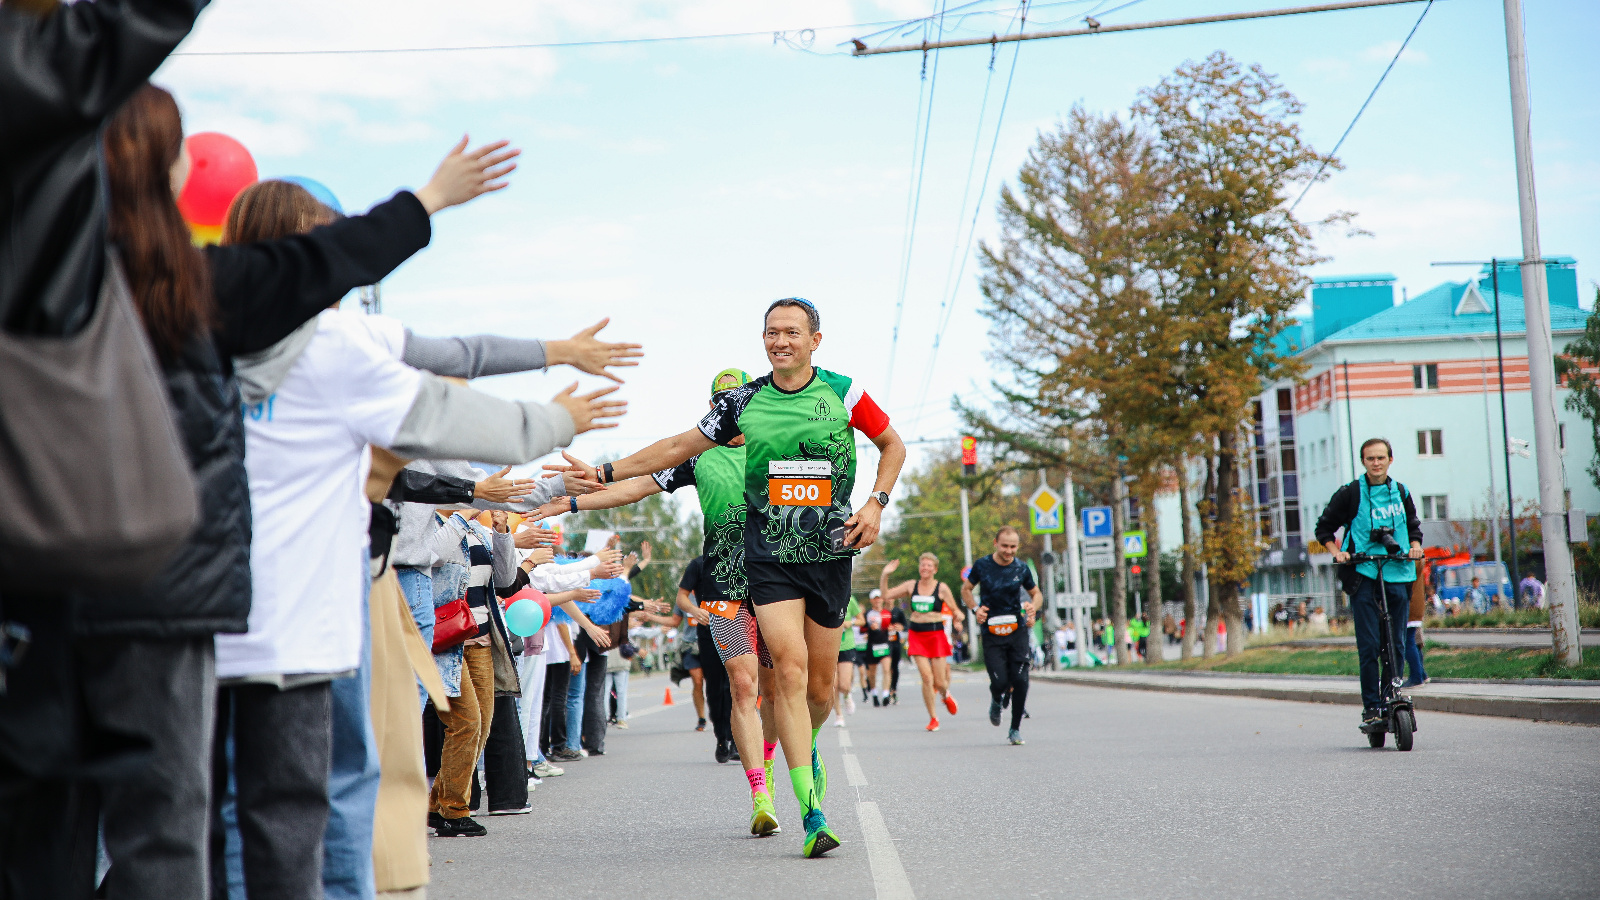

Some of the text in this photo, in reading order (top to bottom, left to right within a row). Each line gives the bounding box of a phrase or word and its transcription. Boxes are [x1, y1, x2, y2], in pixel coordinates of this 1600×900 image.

[781, 484, 819, 501] 500
[1371, 502, 1405, 520] СМИ
[1088, 511, 1106, 534] P
[994, 626, 1013, 635] 566
